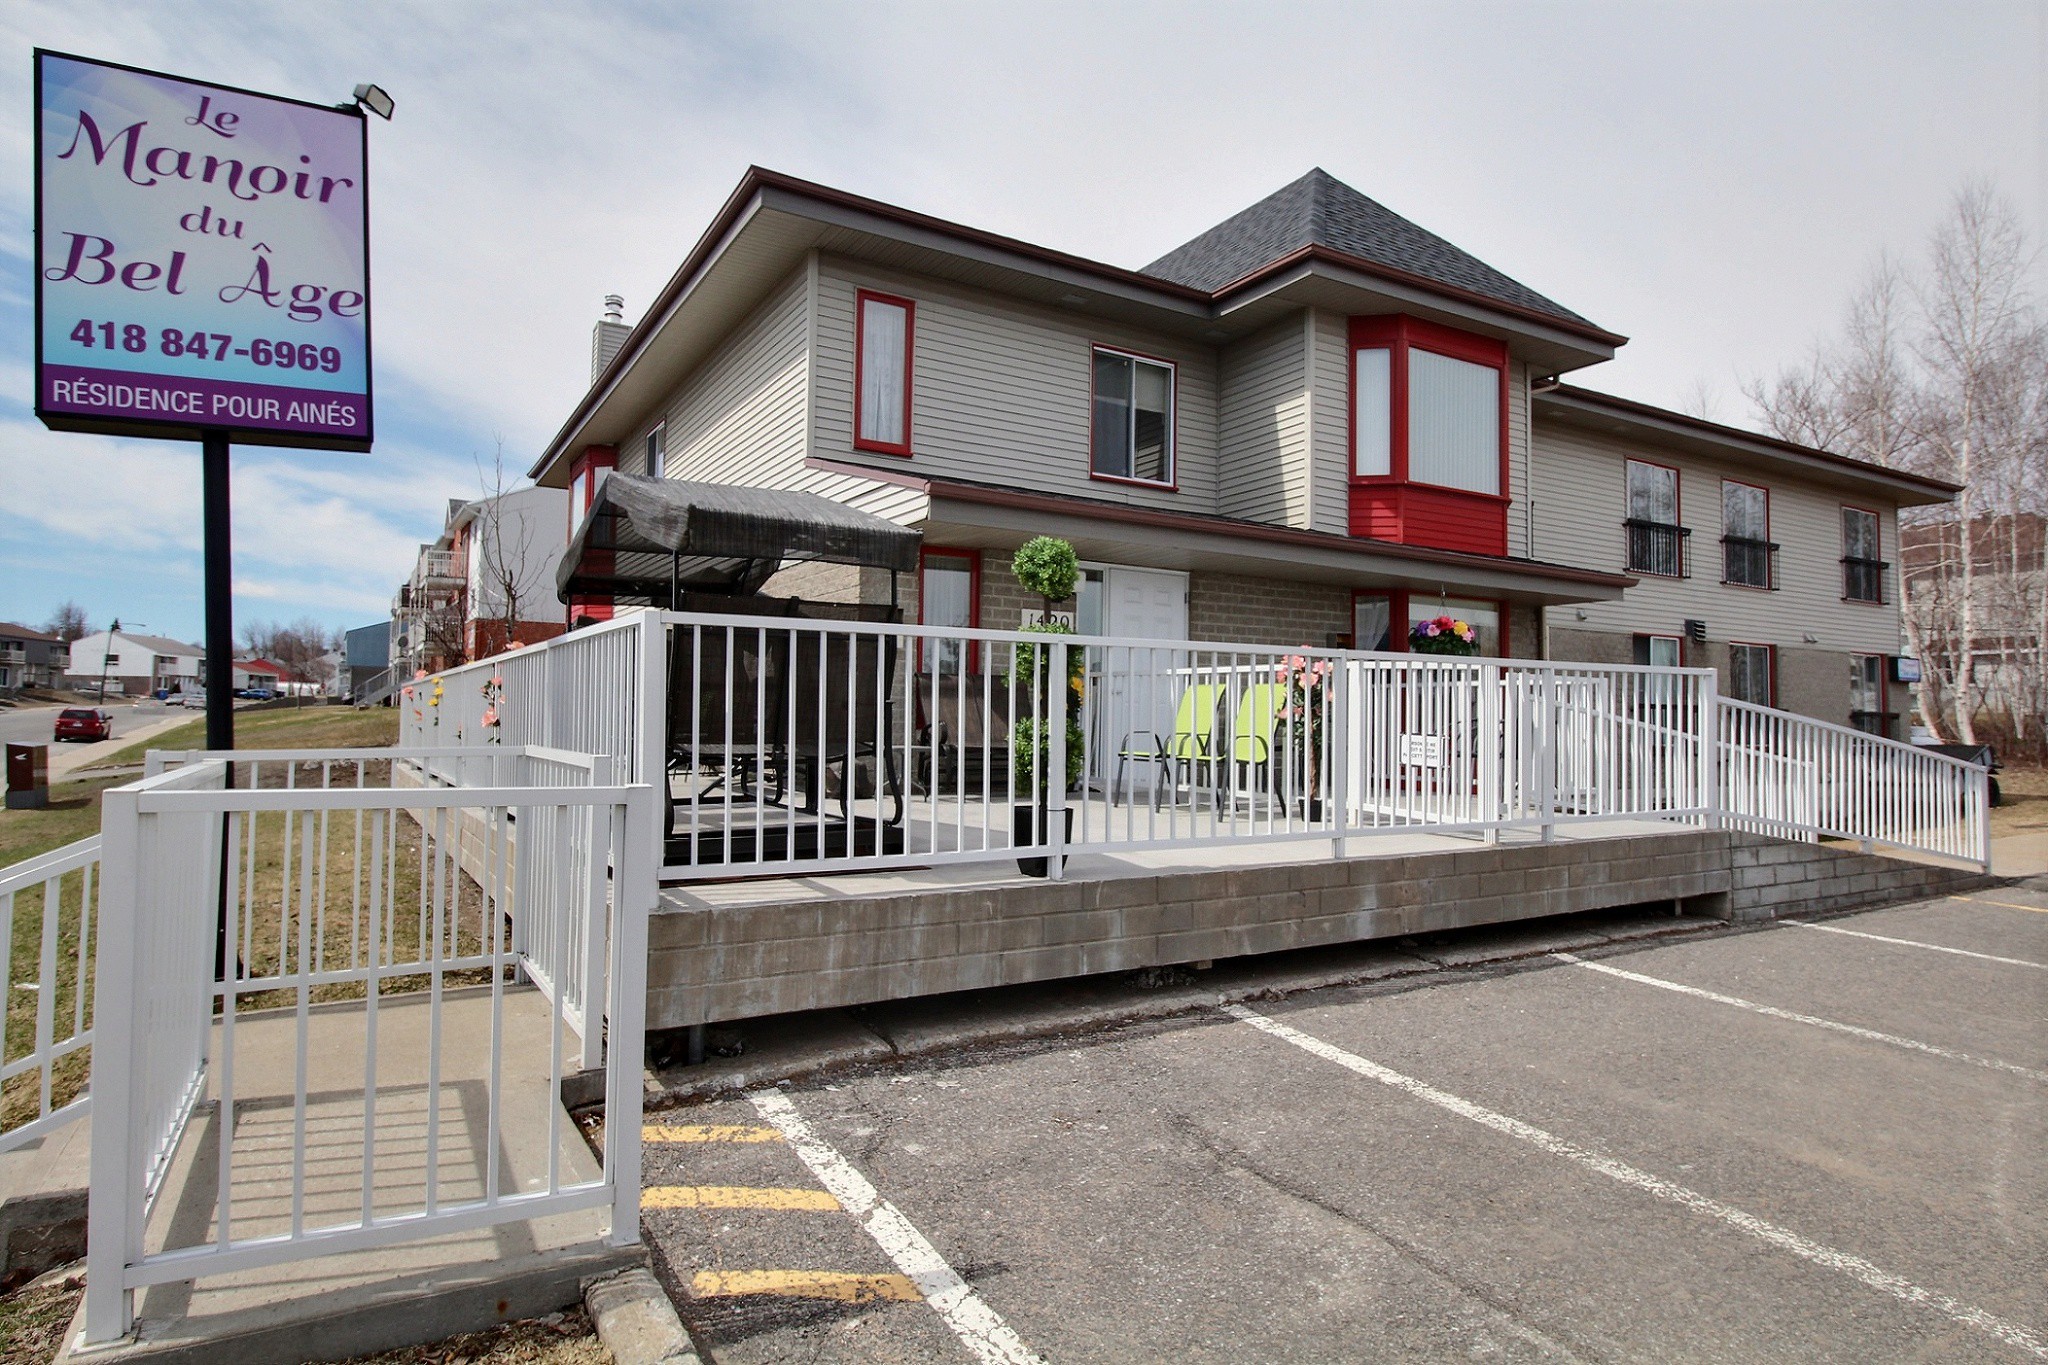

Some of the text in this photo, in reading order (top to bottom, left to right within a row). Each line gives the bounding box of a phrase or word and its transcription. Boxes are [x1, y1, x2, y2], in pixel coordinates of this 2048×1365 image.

[184, 96, 240, 138] Le
[57, 109, 354, 204] Manoir
[179, 205, 245, 239] du
[44, 231, 364, 323] Bel Âge
[69, 318, 341, 374] 418 847-6969
[53, 376, 356, 427] RÉSIDENCE POUR AINÉS
